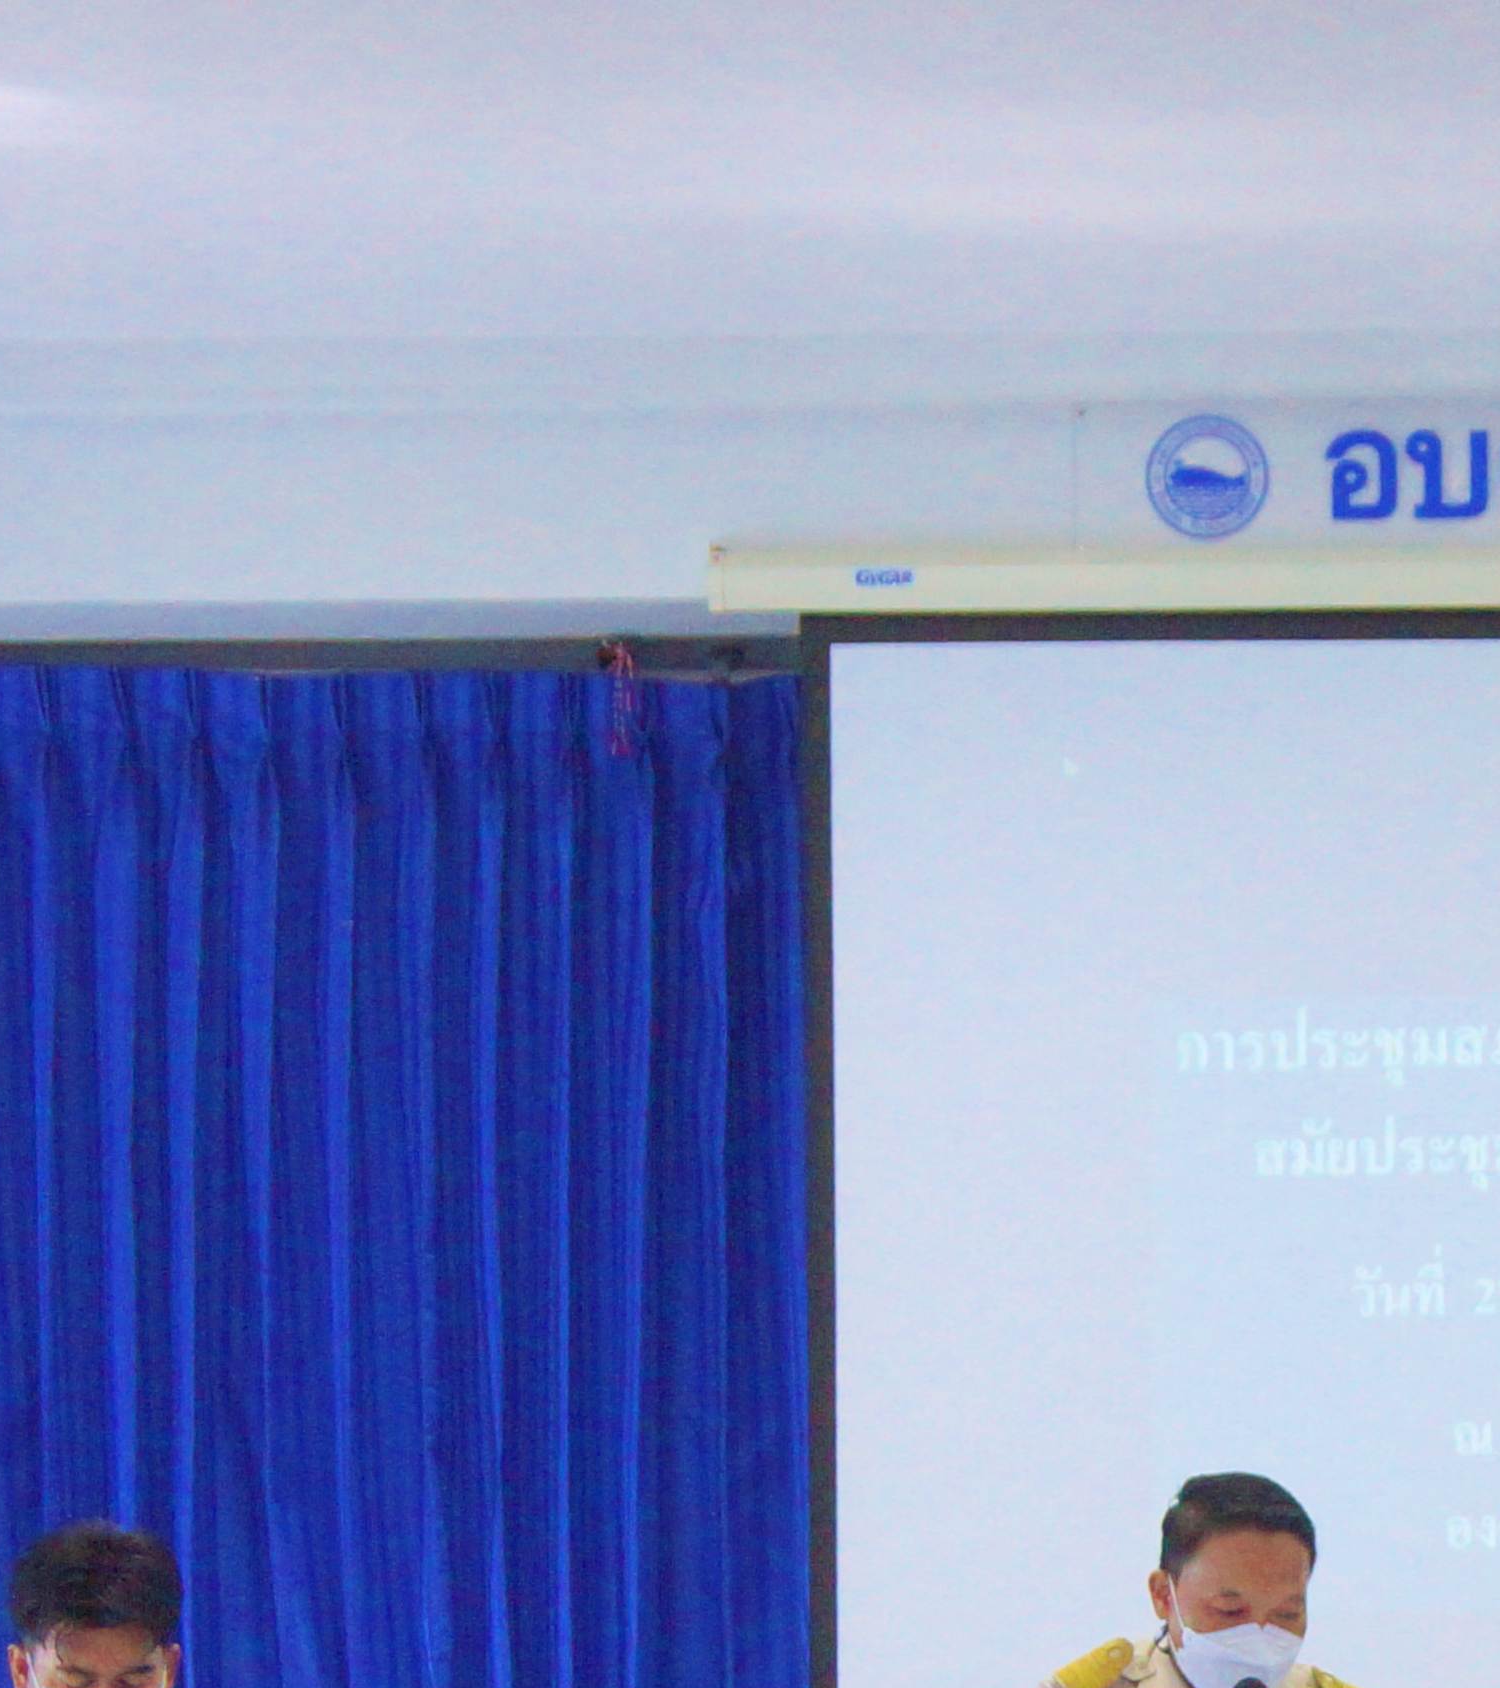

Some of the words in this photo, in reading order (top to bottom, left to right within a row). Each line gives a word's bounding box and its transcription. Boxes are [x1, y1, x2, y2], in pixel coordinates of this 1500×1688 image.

[1351, 1243, 1445, 1317] วันที่
[1452, 1419, 1494, 1456] ณ
